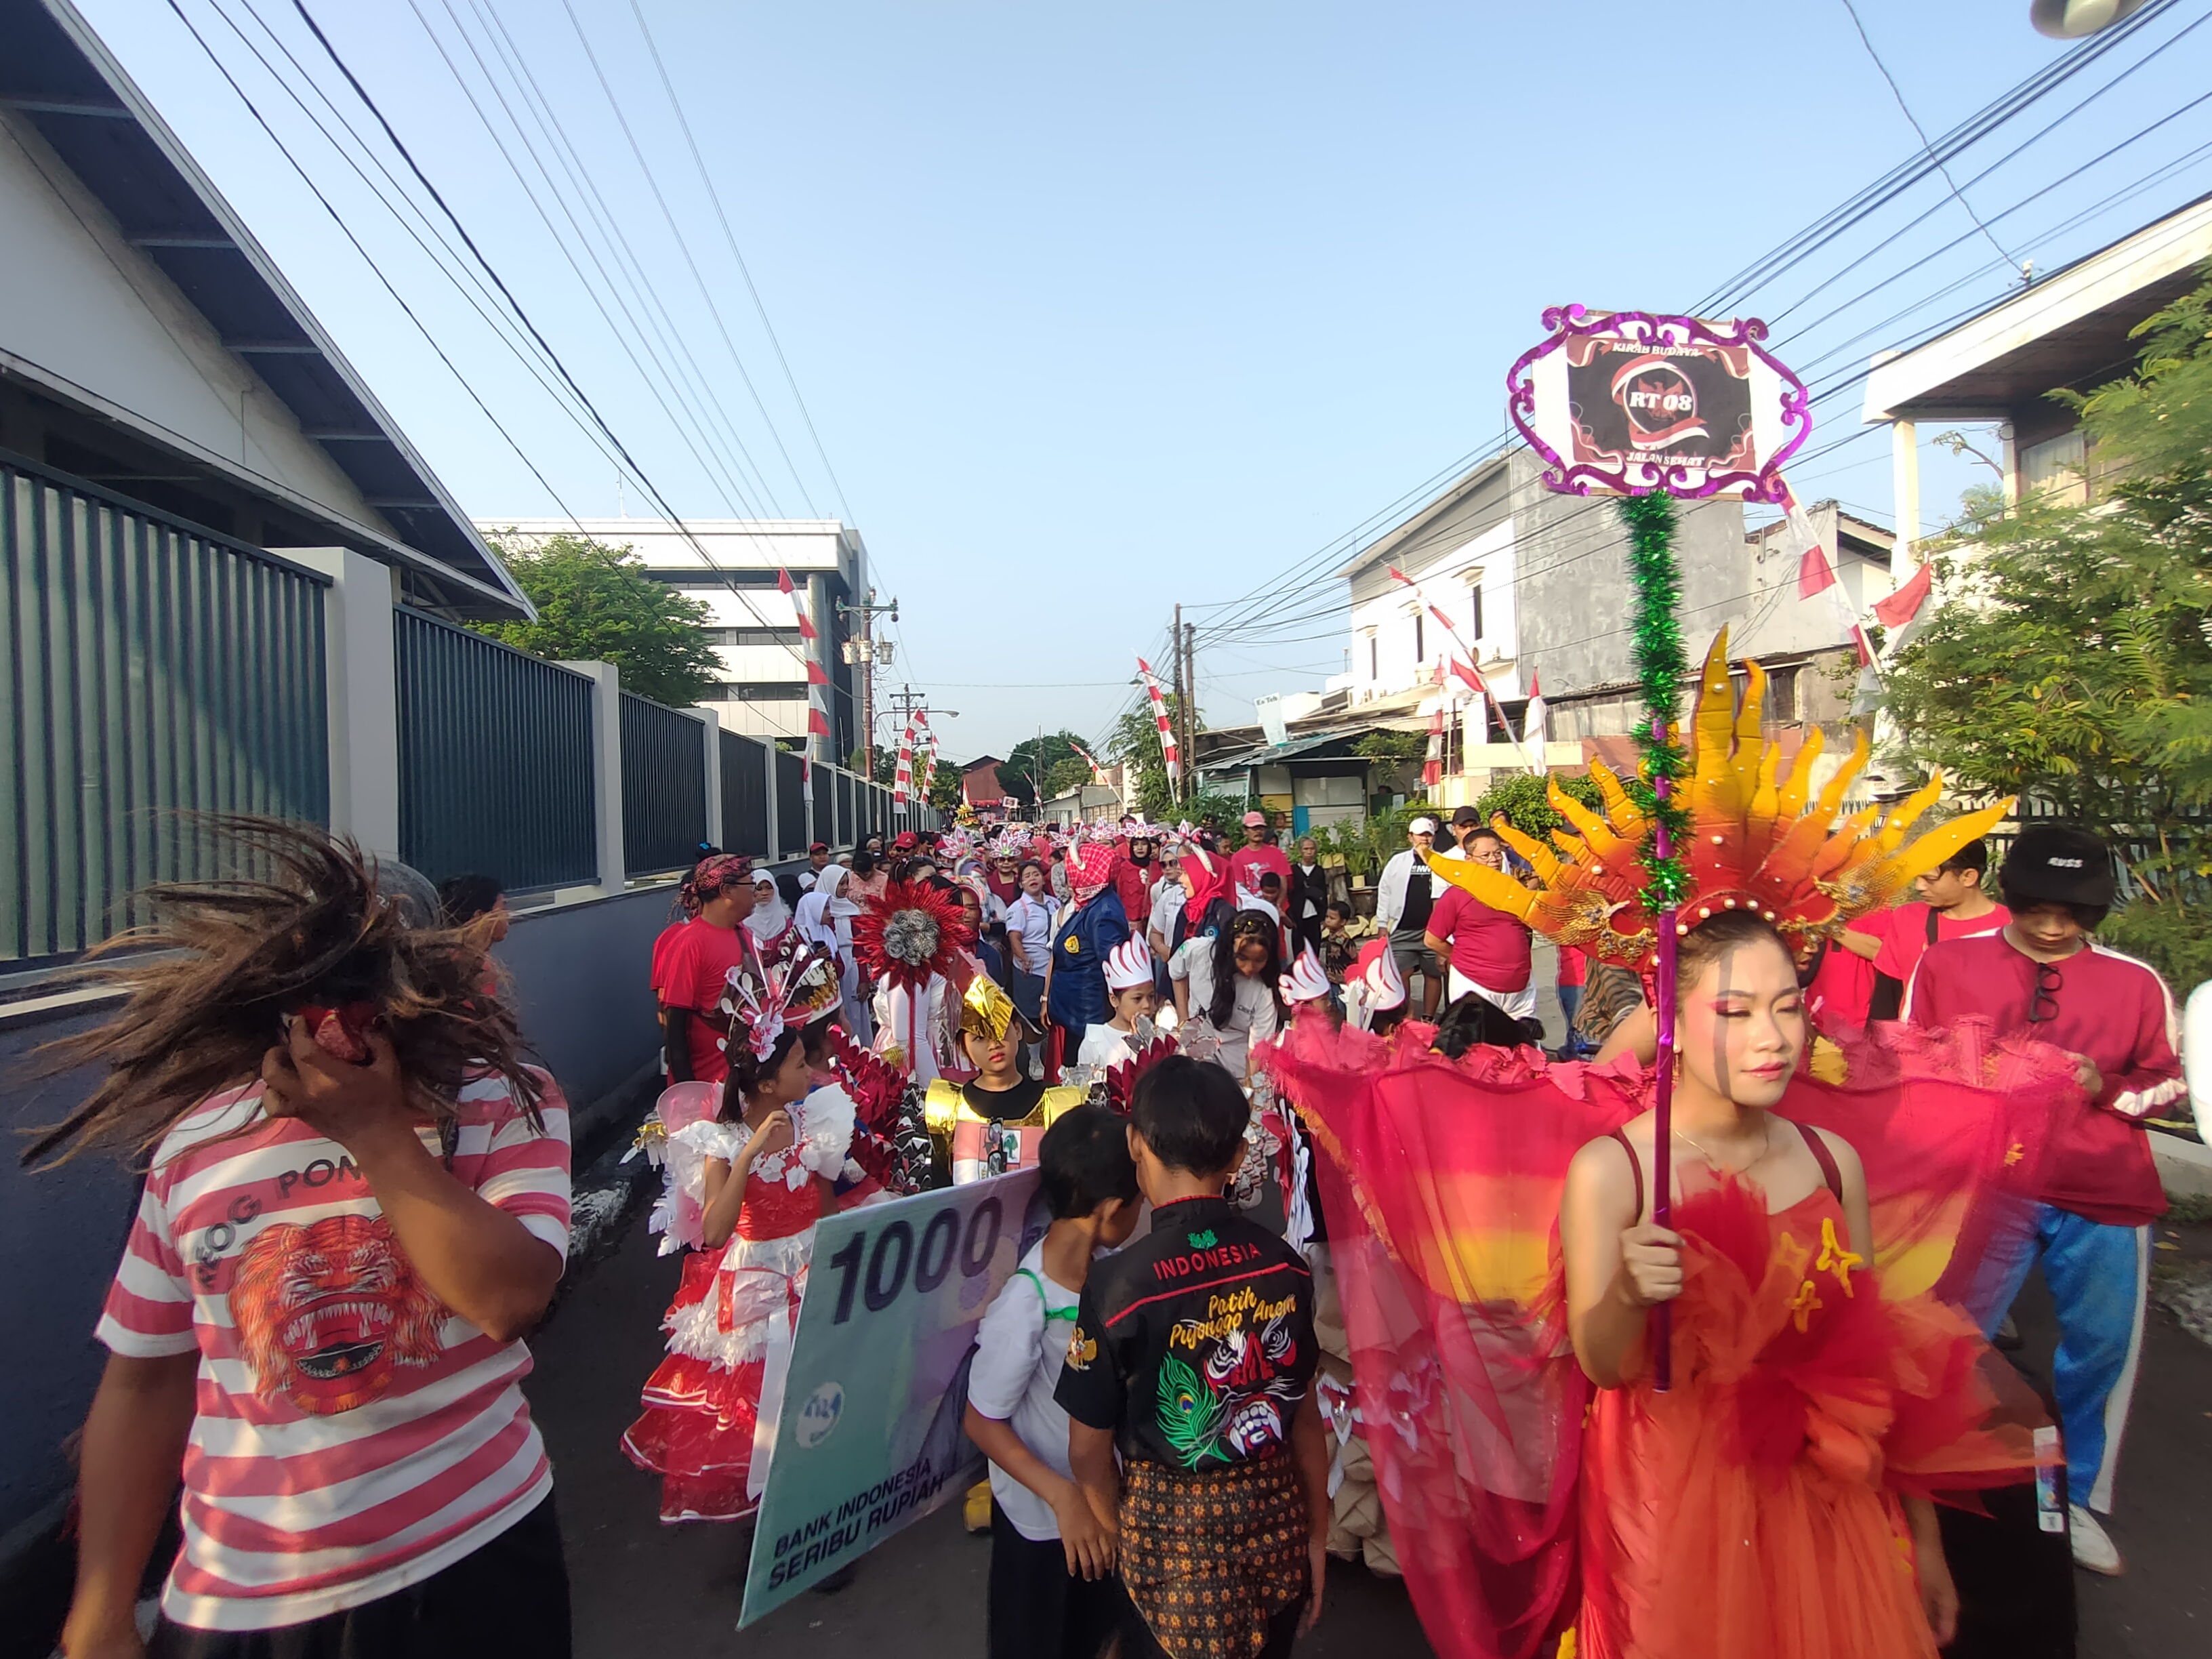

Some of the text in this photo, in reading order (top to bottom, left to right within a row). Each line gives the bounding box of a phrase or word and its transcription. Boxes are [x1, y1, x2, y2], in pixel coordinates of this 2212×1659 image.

[1612, 342, 1650, 354] KIRAB
[1629, 391, 1693, 411] RT 08
[1626, 452, 1705, 466] JALAN SEHAT
[830, 1196, 1003, 1326] 1000
[1153, 1242, 1262, 1281] INDONESIA
[1208, 1286, 1257, 1319] Patih
[1252, 1295, 1296, 1324] Anom
[773, 1458, 931, 1559] BANK INDONESIA
[769, 1471, 945, 1591] SERIBU RUPIAH
